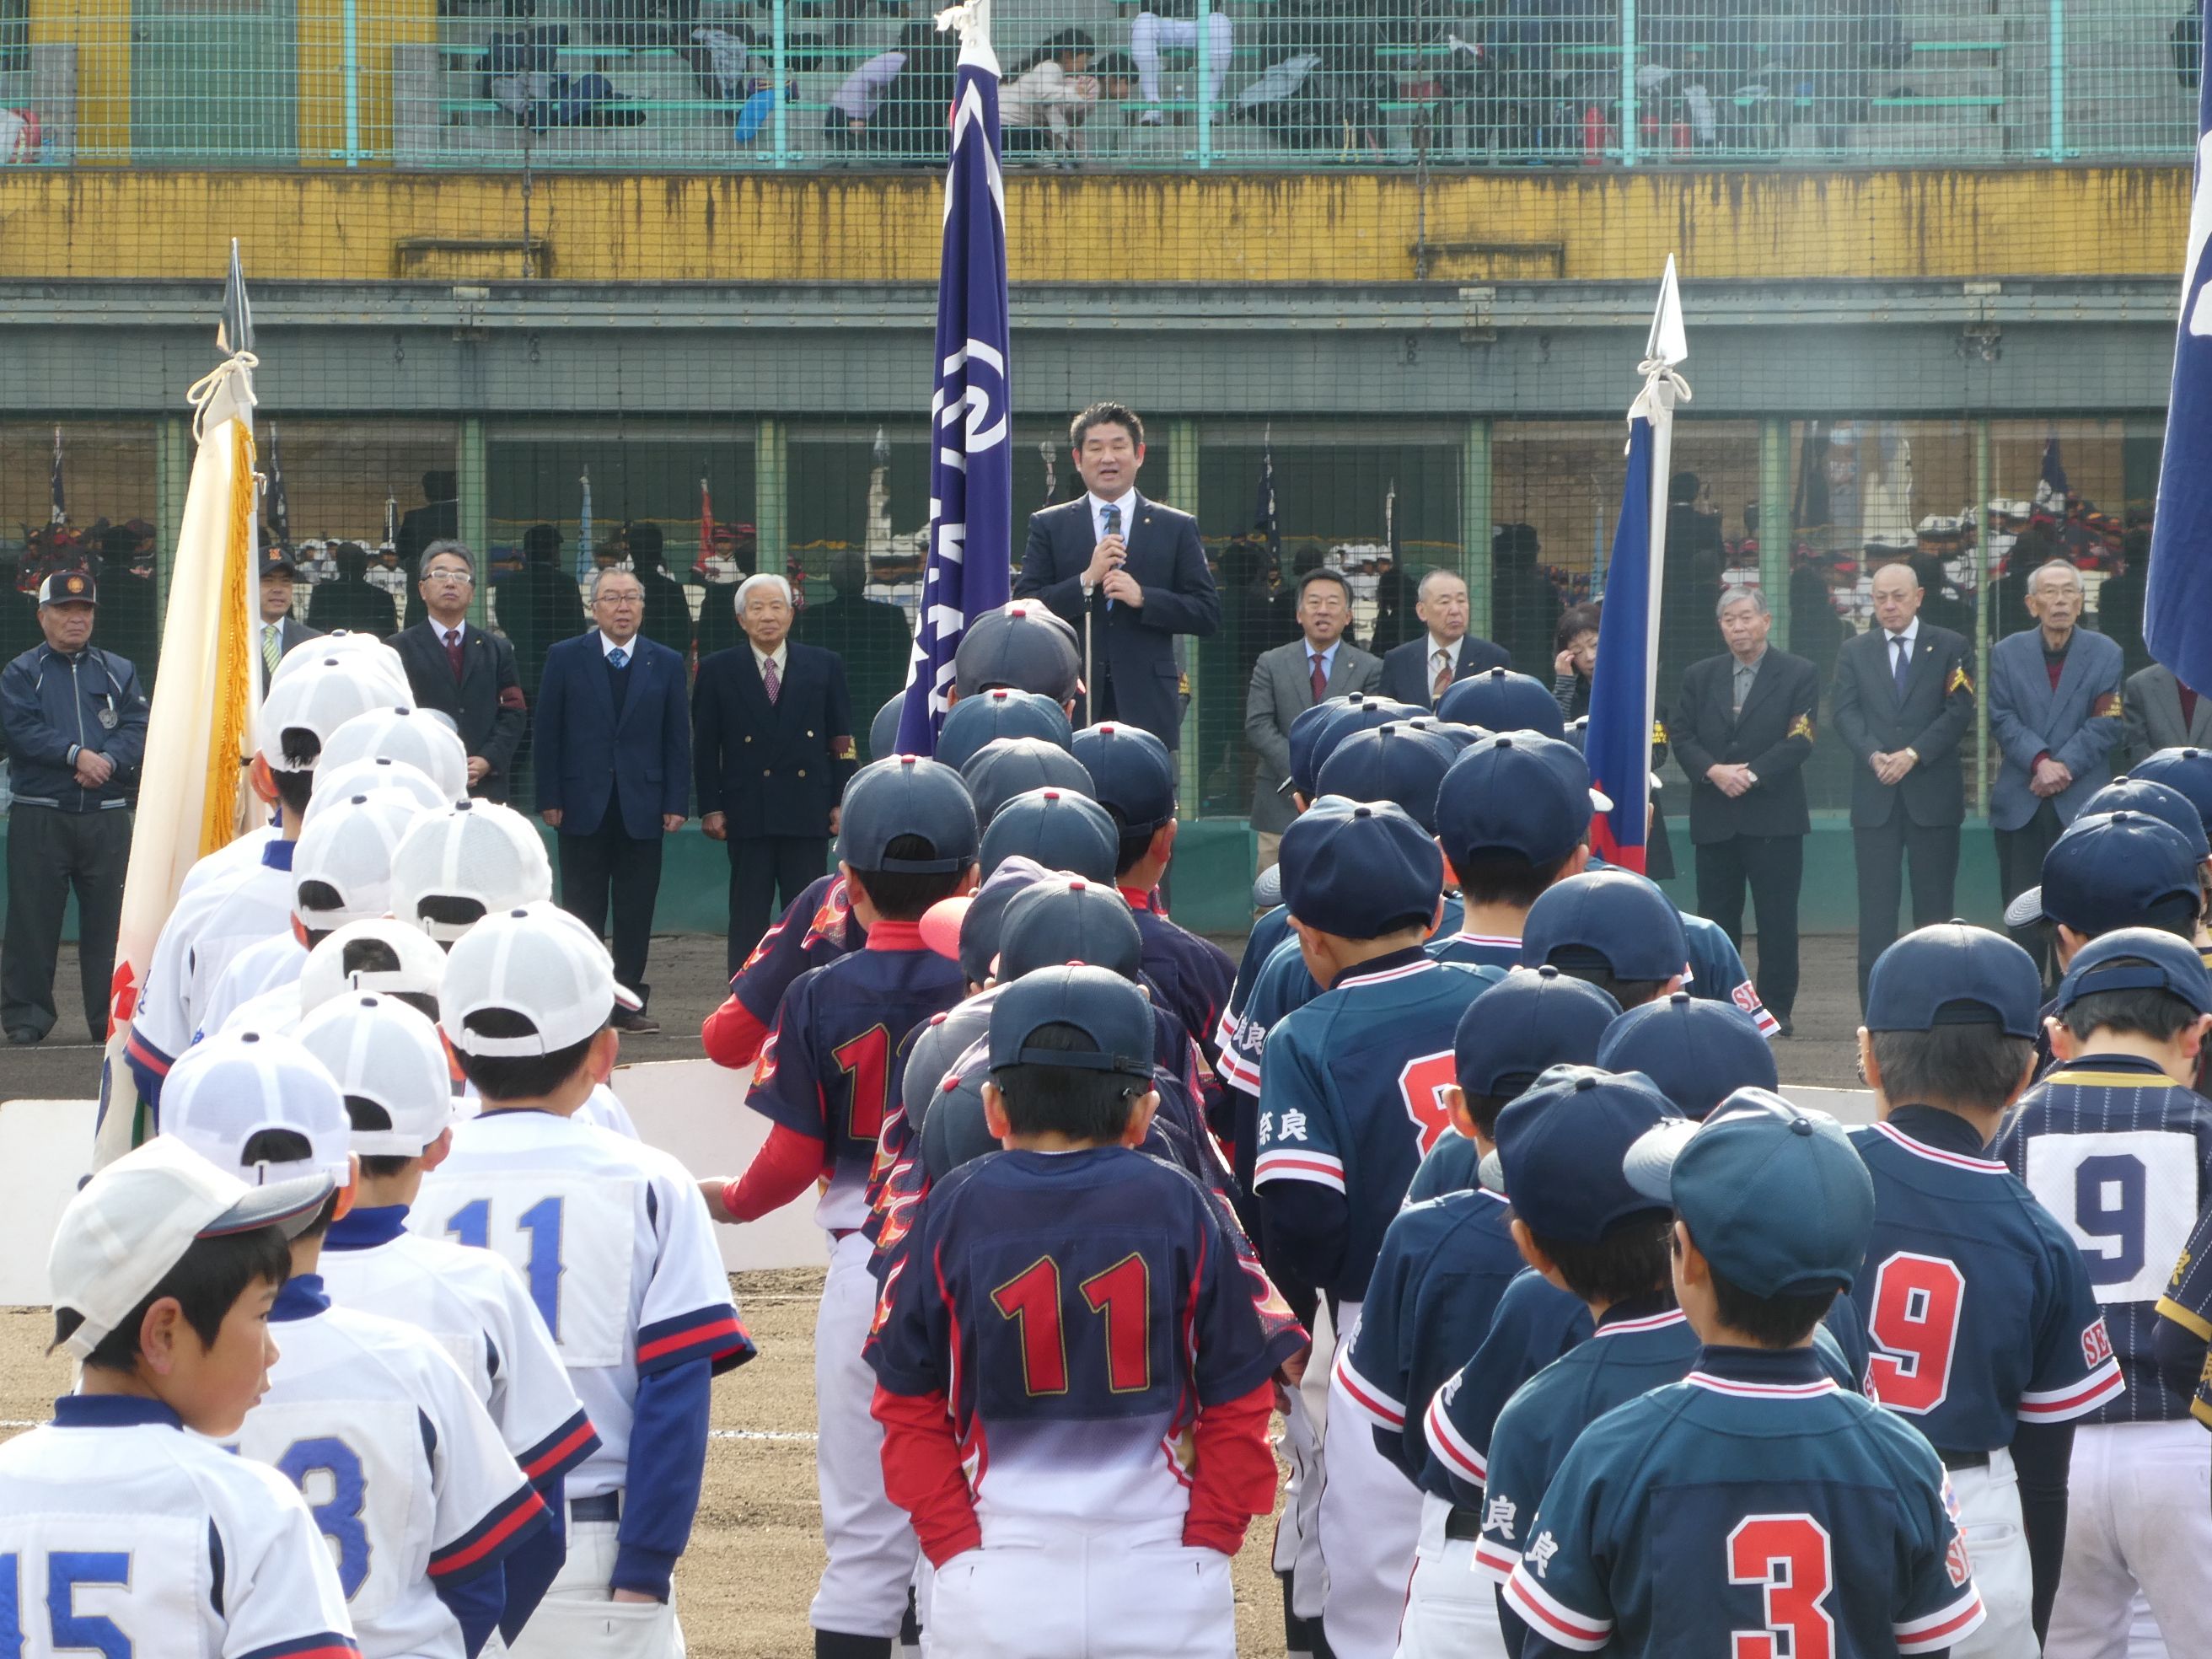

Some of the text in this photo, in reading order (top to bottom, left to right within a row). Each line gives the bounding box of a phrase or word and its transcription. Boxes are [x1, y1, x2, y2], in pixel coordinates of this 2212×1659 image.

[831, 1022, 910, 1141] 1
[2075, 1153, 2146, 1286] 9
[990, 1251, 1150, 1397] 11
[1868, 1251, 1966, 1415] 9
[2081, 1319, 2113, 1369] SE
[1726, 1513, 1836, 1659] 3
